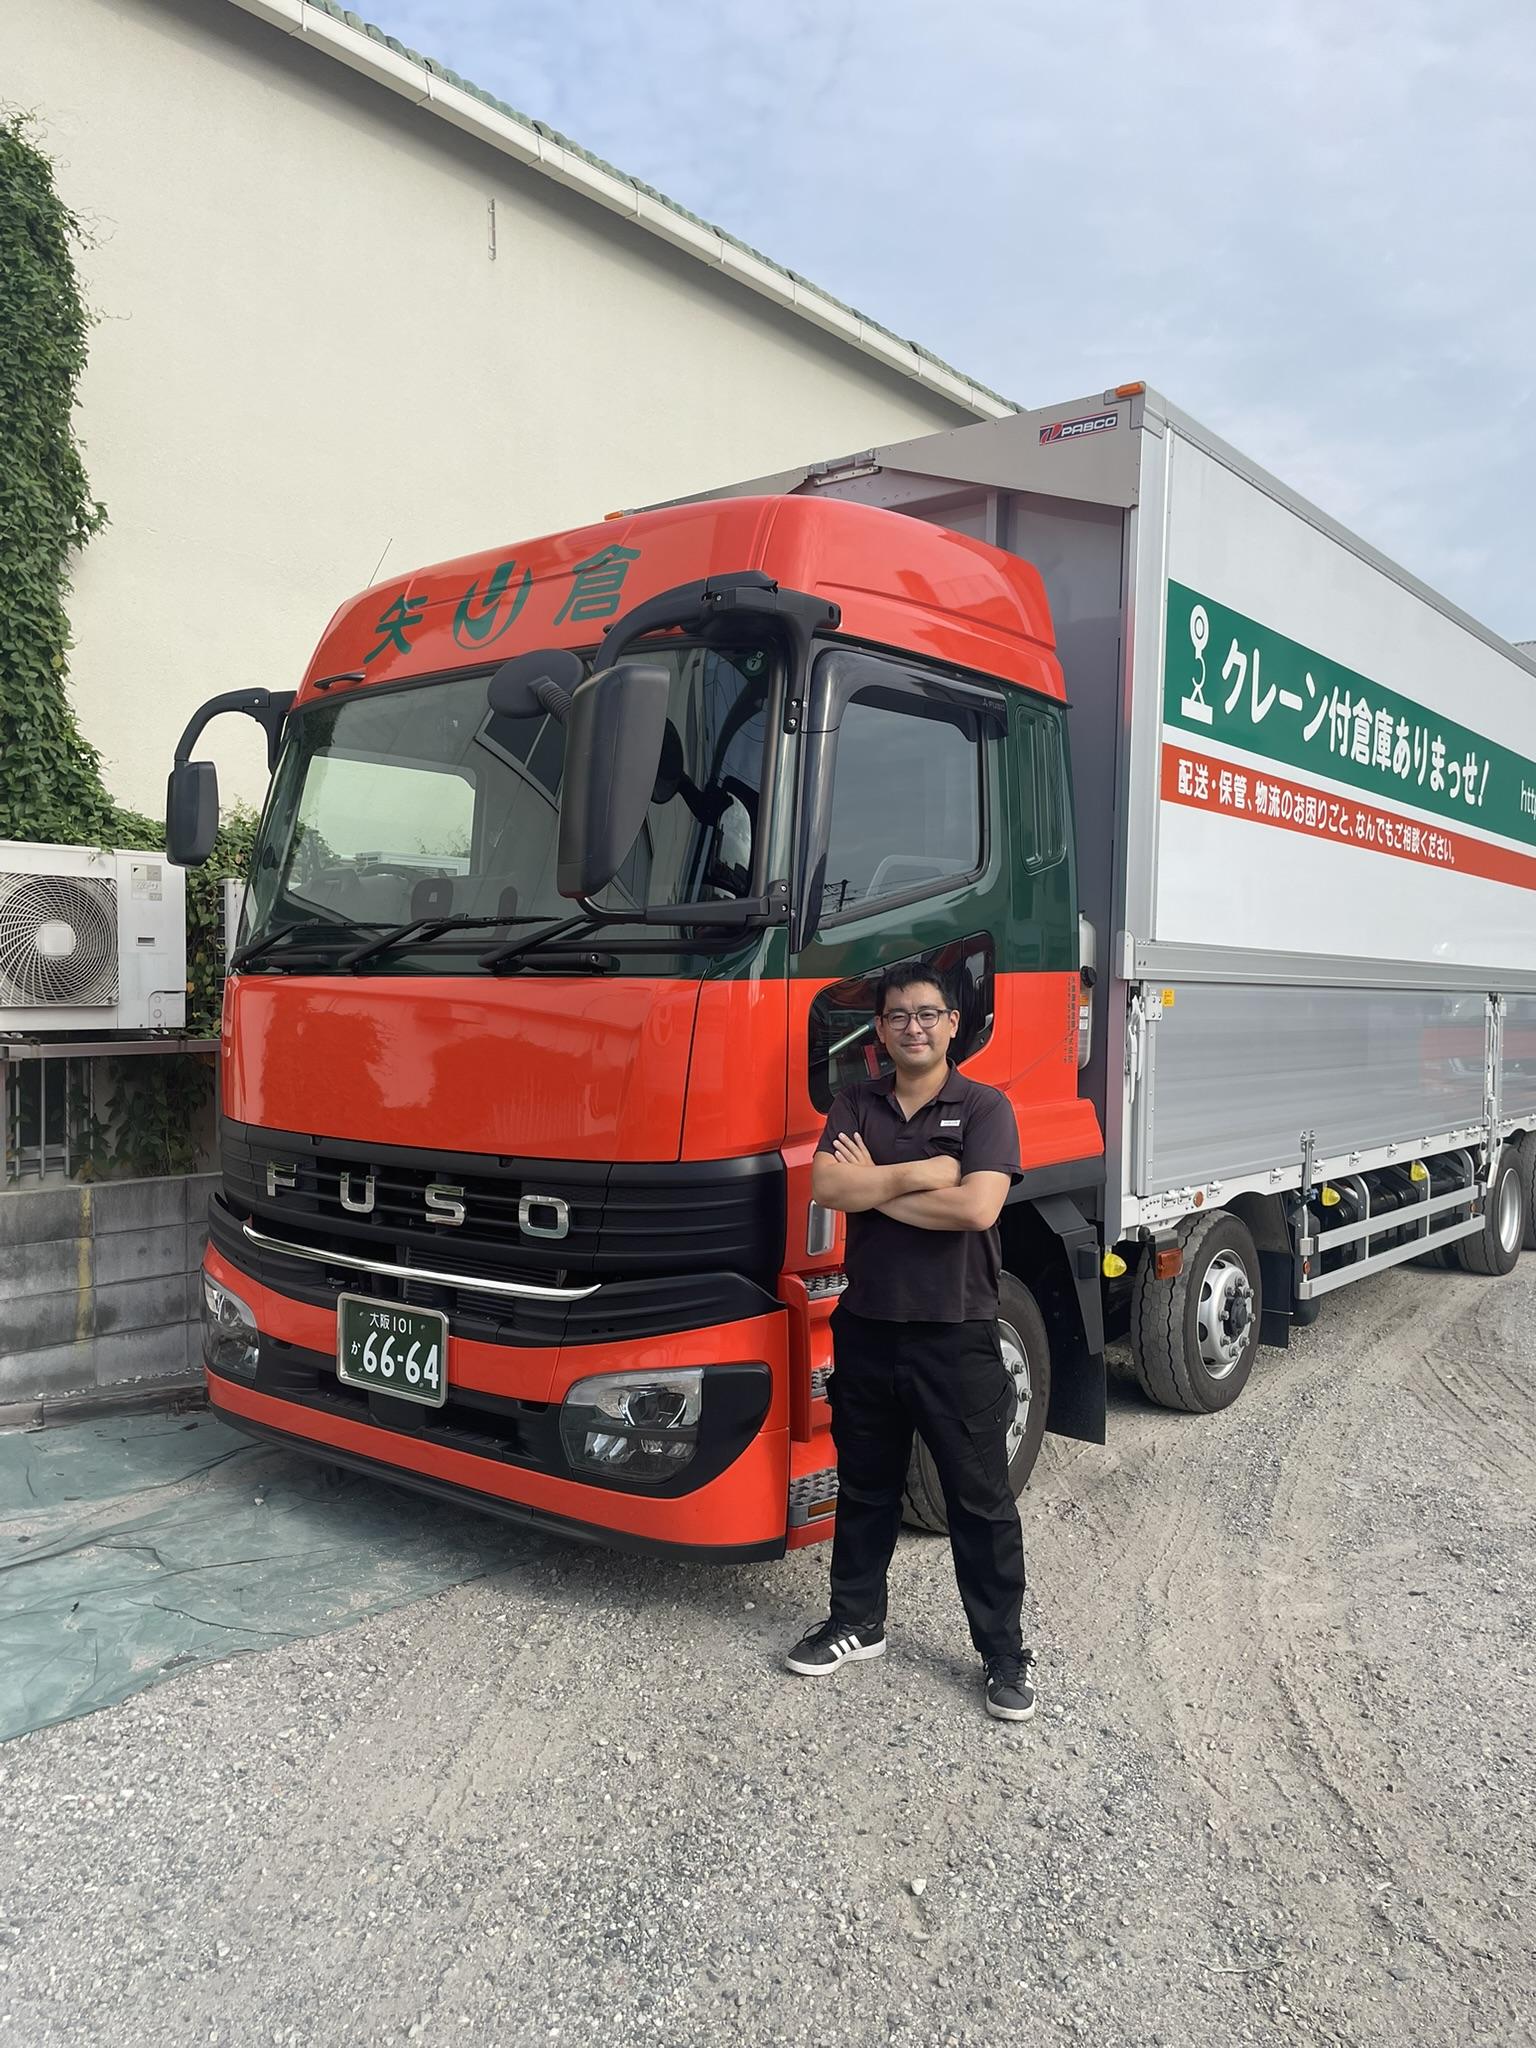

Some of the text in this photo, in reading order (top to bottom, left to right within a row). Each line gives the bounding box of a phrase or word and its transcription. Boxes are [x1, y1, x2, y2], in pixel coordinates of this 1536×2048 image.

[1061, 416, 1117, 437] PABCO
[553, 544, 642, 625] 倉
[1222, 638, 1489, 807] クレーン付倉庫ありまっせ!
[266, 1160, 570, 1240] FUSO
[350, 1331, 439, 1389] か 66-64
